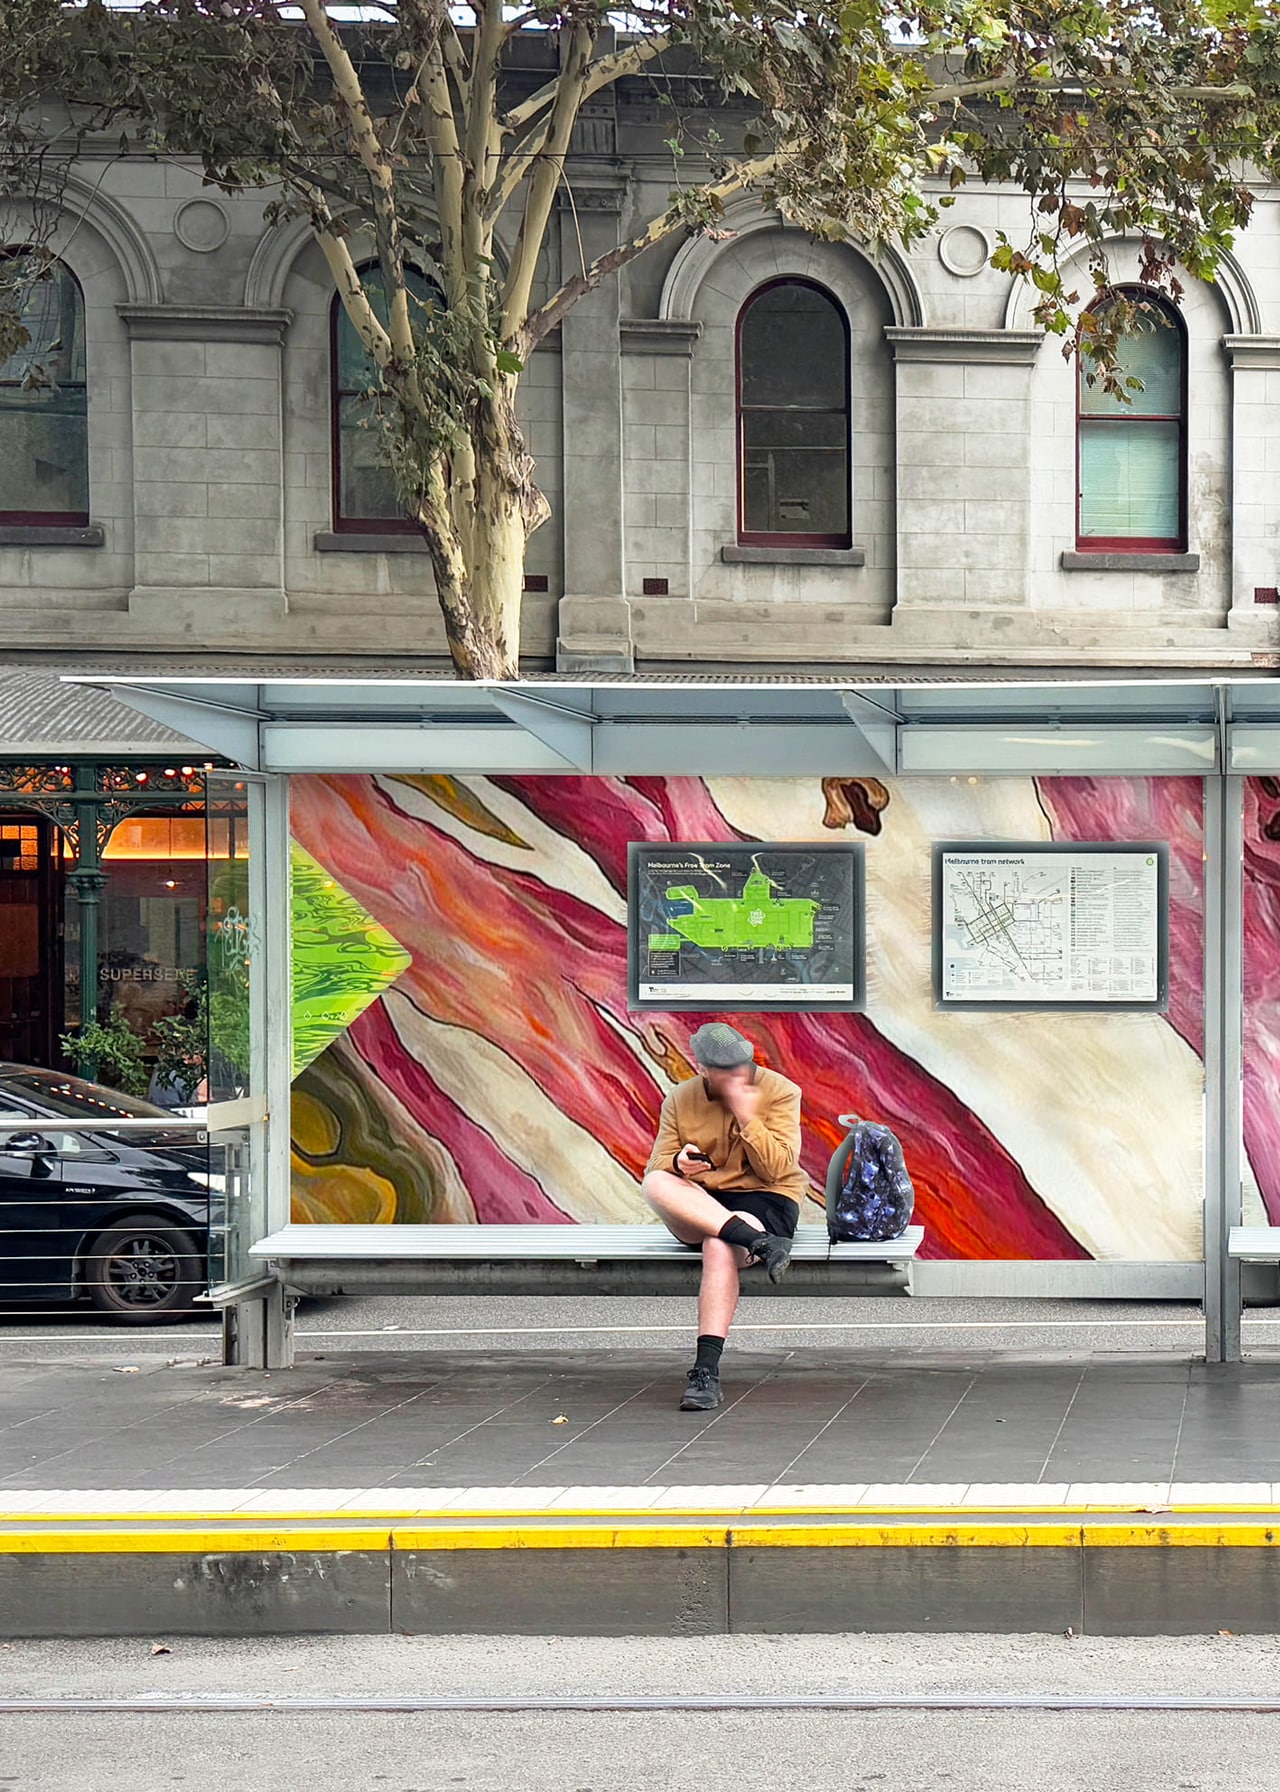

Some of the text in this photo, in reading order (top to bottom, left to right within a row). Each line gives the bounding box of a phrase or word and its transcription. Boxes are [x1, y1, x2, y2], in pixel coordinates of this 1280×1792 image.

[647, 861, 684, 869] Melbourne's
[684, 861, 698, 869] Free
[715, 861, 731, 869] Zone
[944, 857, 1025, 866] Melbourne tram network
